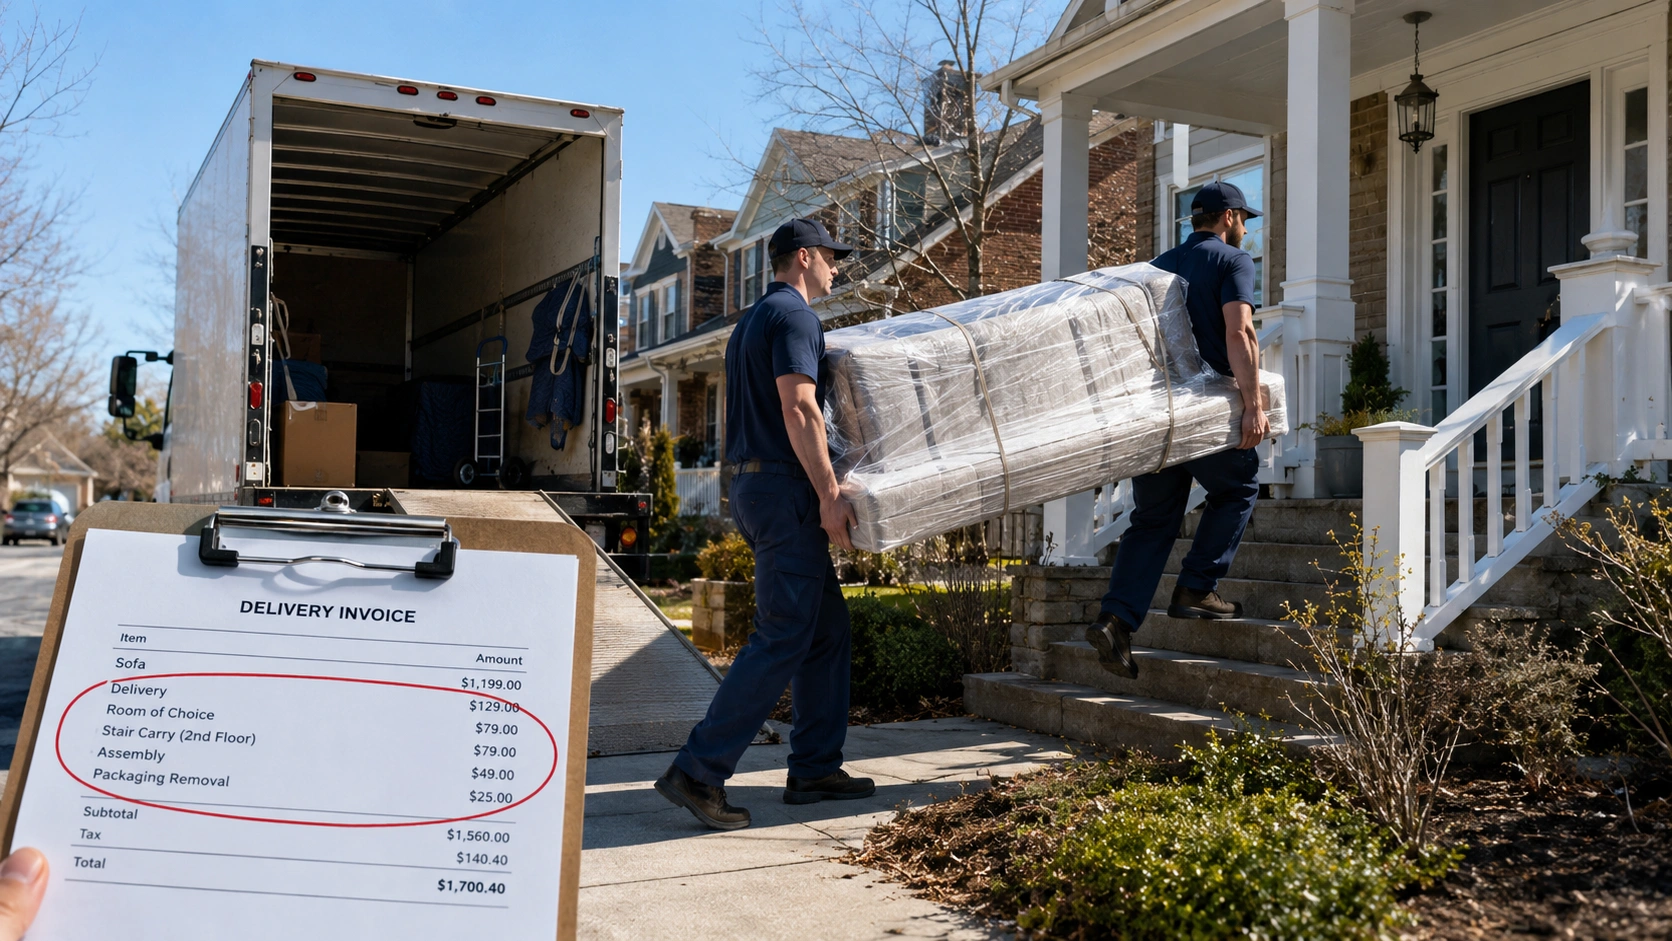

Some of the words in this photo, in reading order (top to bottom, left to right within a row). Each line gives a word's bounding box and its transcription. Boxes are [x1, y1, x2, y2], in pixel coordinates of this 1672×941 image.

[240, 601, 334, 618] DELIVERY
[339, 606, 416, 623] INVOICE
[121, 633, 146, 643] Item
[116, 658, 145, 669] Sofa
[476, 654, 522, 665] Amount
[462, 677, 521, 690] $1,199.00
[111, 682, 167, 699] Delivery
[107, 704, 146, 716] Room
[151, 707, 164, 717] of
[168, 708, 214, 720] Choice
[470, 700, 519, 713] $129.00
[476, 722, 518, 735] $79.00
[102, 725, 134, 737] Stair
[139, 727, 175, 742] Carry
[180, 730, 211, 742] (2nd
[215, 732, 255, 746] Floor)
[97, 747, 165, 763] Assembly
[474, 744, 516, 757] $79.00
[93, 769, 165, 786] Packaging
[170, 773, 229, 786] Removal
[472, 767, 514, 780] $49.00
[470, 790, 512, 803] $25.00
[84, 806, 138, 819] Subtotal
[80, 828, 102, 840] Tax
[447, 828, 509, 843] $1,560.00
[74, 857, 105, 868] Total
[457, 852, 508, 865] $140.40
[438, 879, 505, 894] $1,700.40
